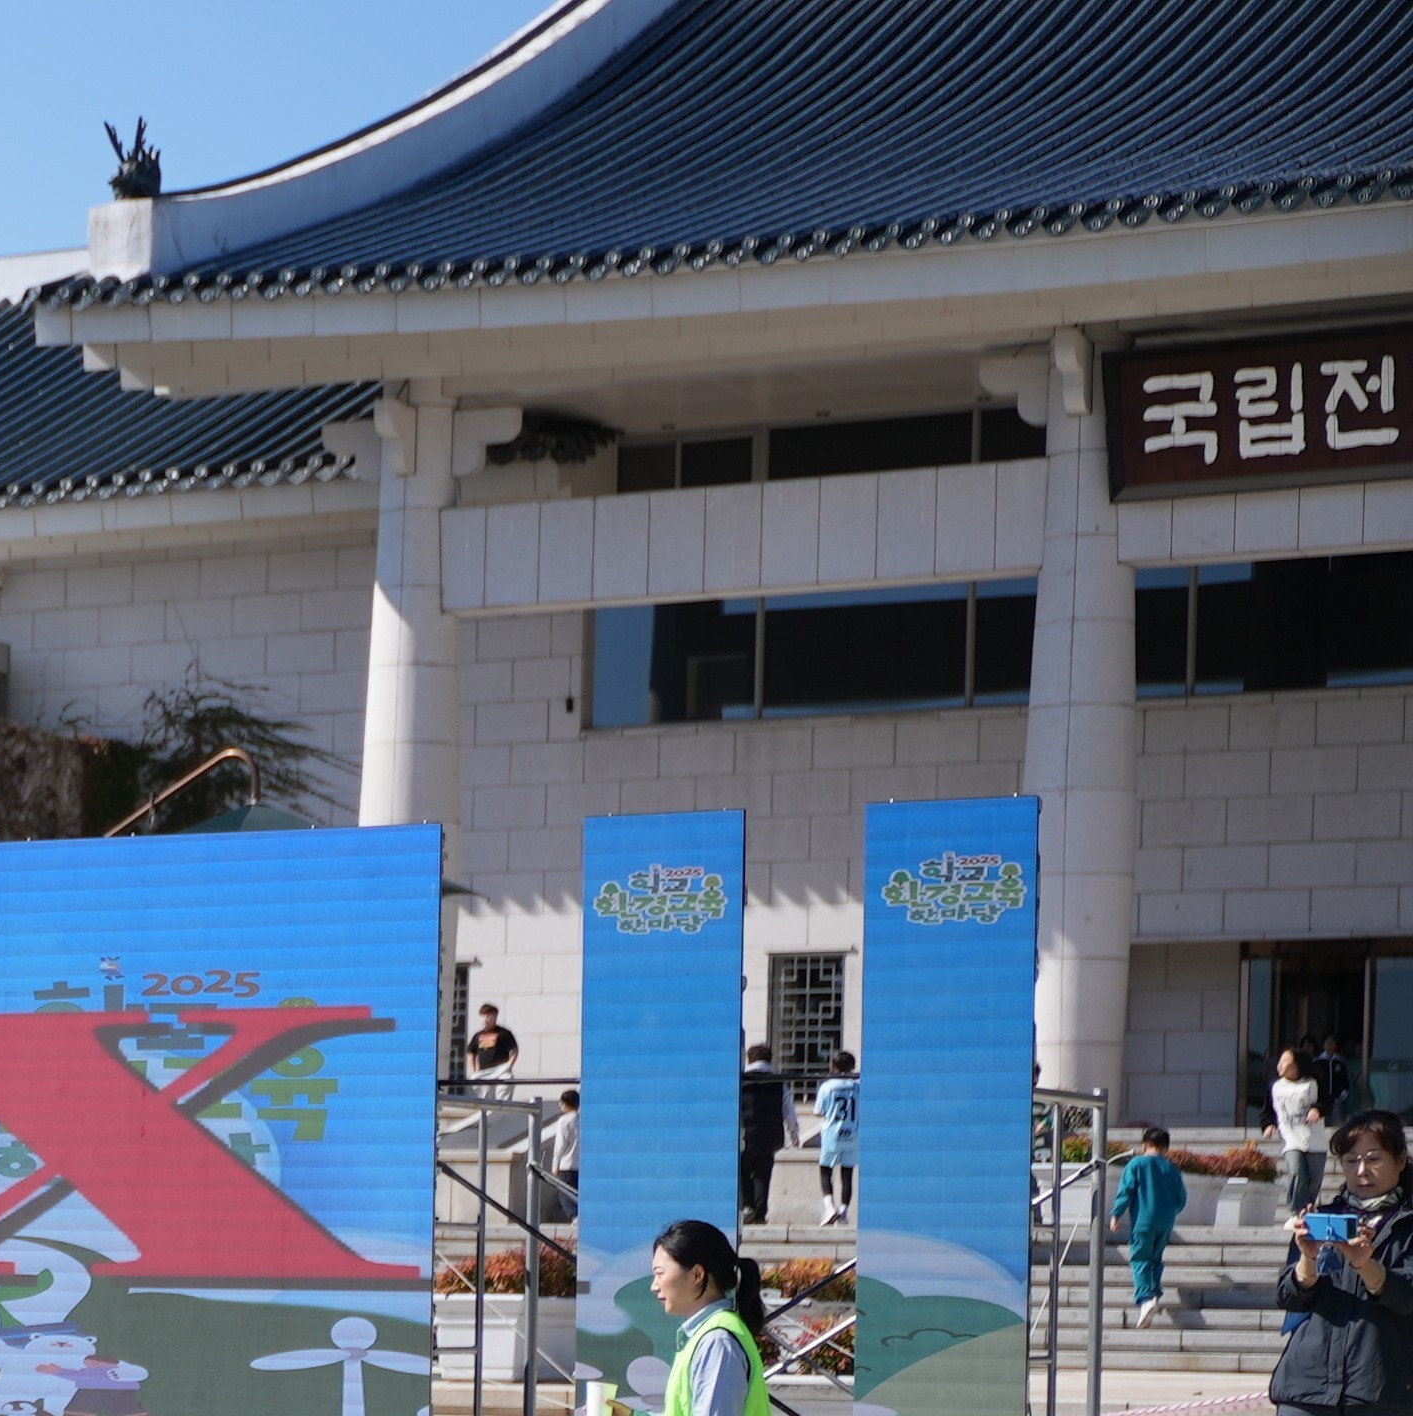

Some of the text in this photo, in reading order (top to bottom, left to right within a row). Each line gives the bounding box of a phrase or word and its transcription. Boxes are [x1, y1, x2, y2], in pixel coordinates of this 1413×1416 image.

[1143, 354, 1400, 465] 국립전
[664, 867, 703, 878] 2025
[922, 858, 986, 883] 학교
[959, 855, 1001, 866] 2025
[630, 870, 689, 894] 학교
[884, 879, 1024, 908] 환경교육
[595, 889, 727, 918] 환경교육
[908, 903, 1002, 924] 한마당
[619, 914, 705, 933] 한마당
[140, 969, 262, 998] 2025
[835, 1096, 855, 1122] 31
